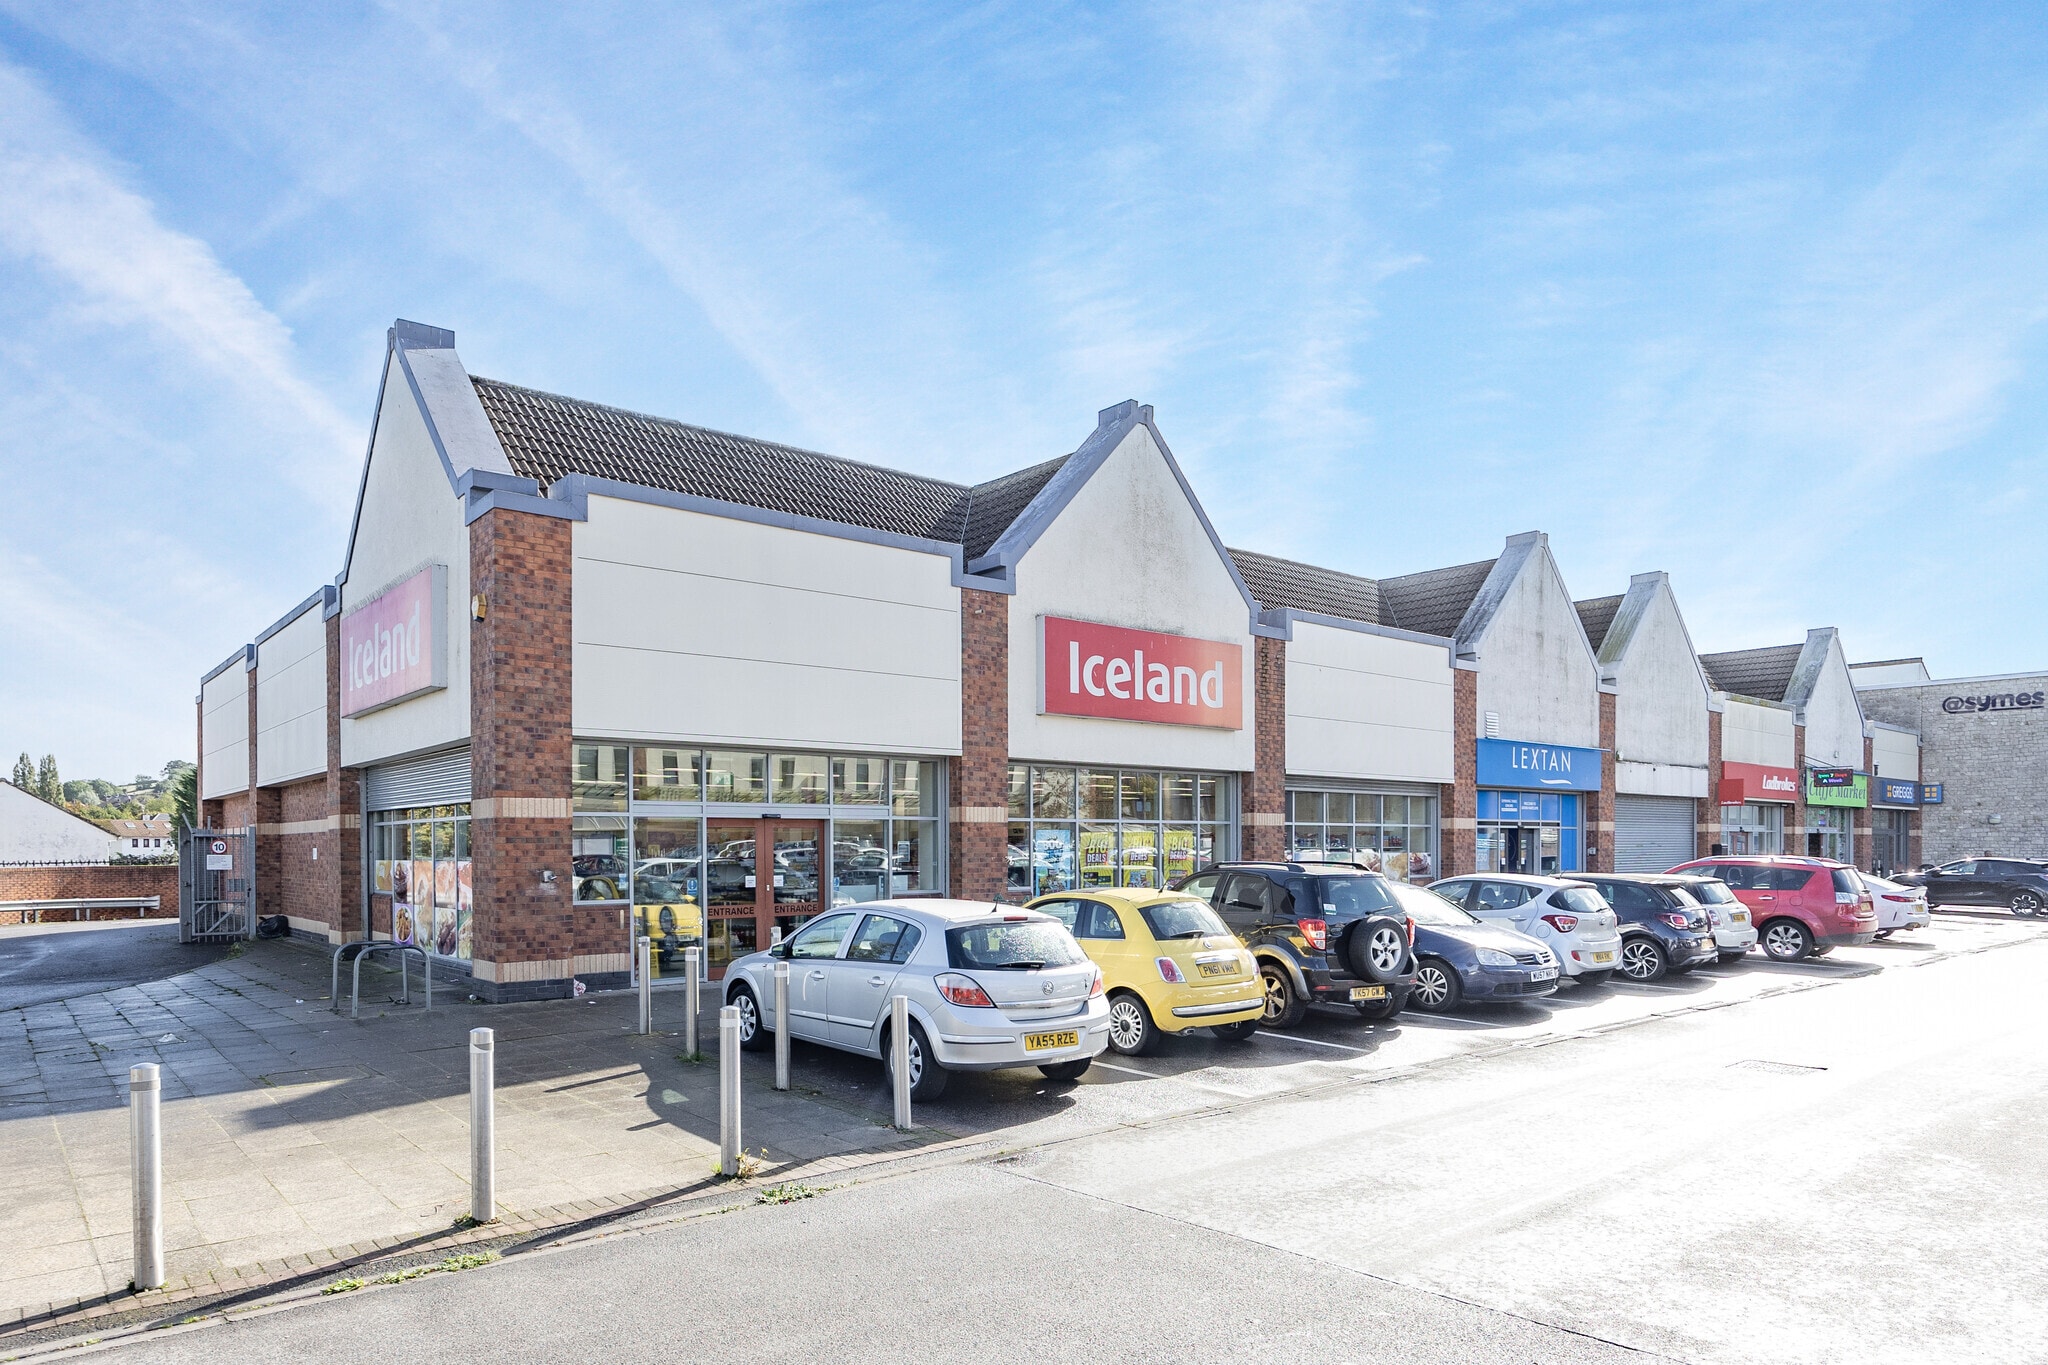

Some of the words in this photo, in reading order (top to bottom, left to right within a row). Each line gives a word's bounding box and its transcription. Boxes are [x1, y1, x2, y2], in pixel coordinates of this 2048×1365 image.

[348, 599, 420, 692] Iceland
[1069, 640, 1224, 709] Iceland
[1941, 691, 2045, 714] @symes
[1512, 746, 1571, 773] LEXTAN
[1892, 785, 1913, 799] GREGGS
[213, 843, 225, 851] 10
[1086, 852, 1107, 863] DEALS
[708, 906, 755, 917] ENTRANCE
[774, 903, 818, 914] ENTRANCE
[1028, 1034, 1055, 1048] YA55
[1057, 1032, 1075, 1045] RZE
